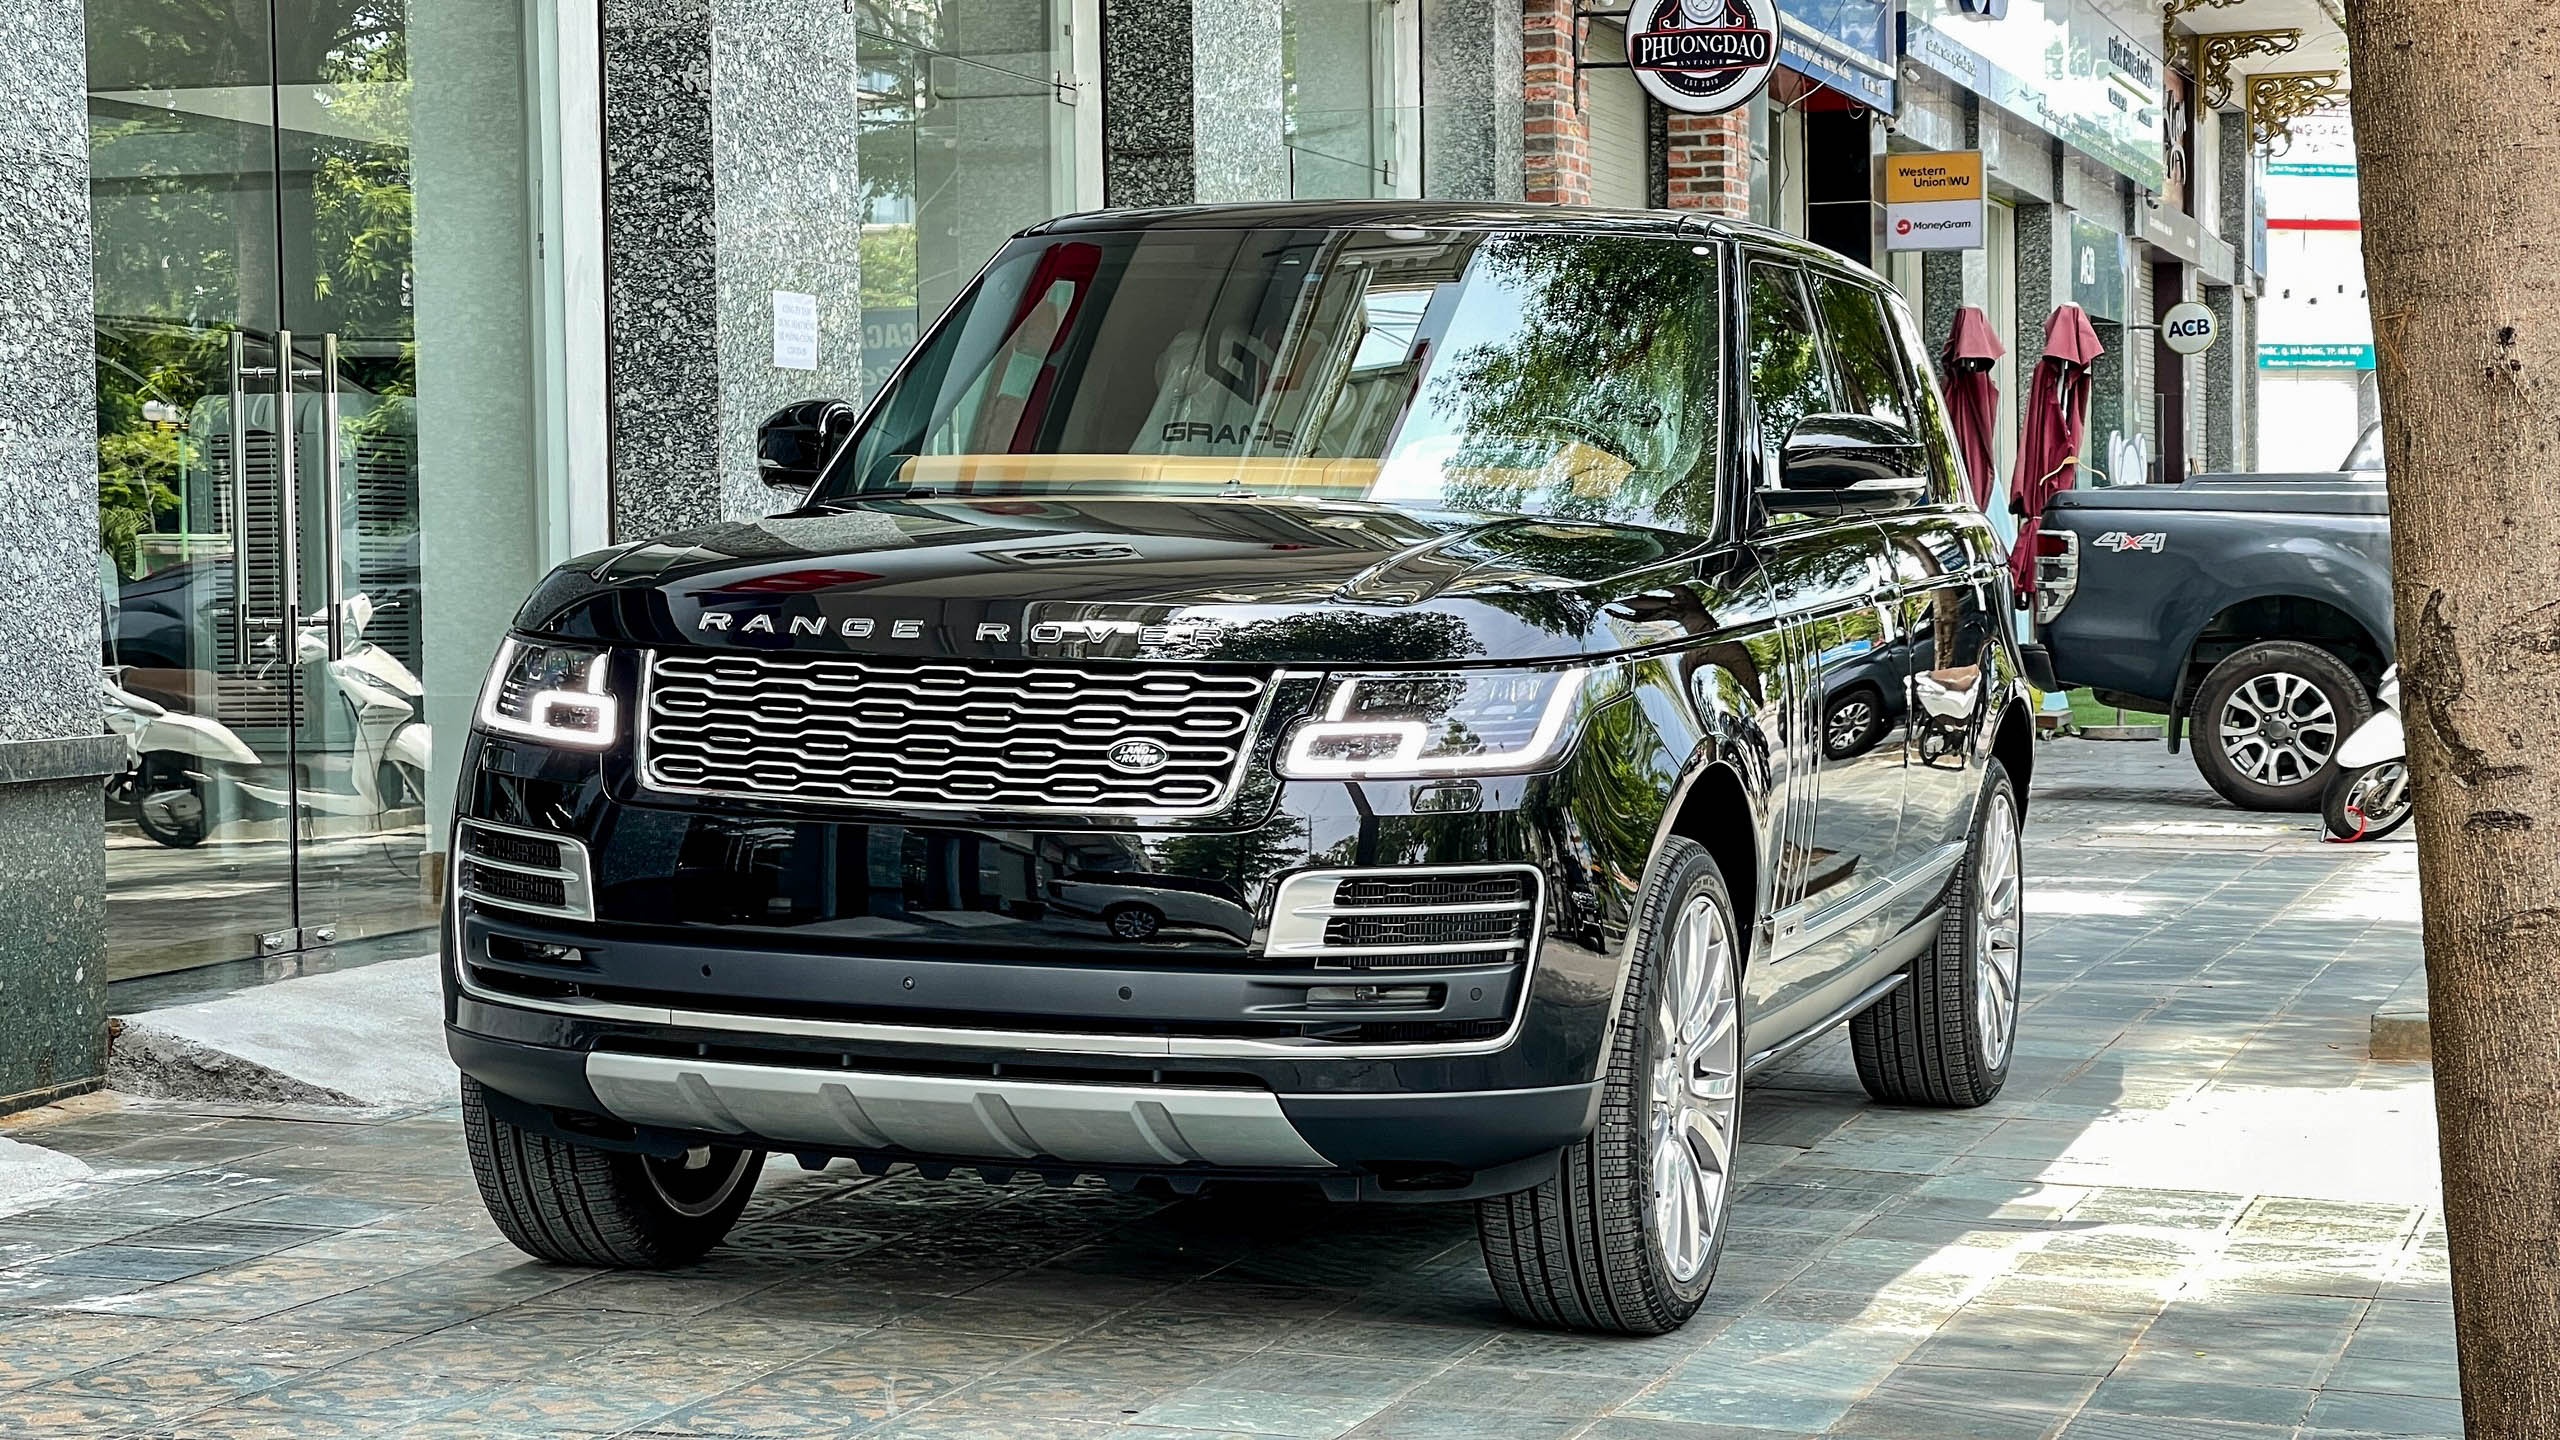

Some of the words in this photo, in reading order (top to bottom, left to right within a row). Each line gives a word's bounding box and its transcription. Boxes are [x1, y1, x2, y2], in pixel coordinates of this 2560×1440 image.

[1640, 33, 1766, 64] PHUONGDAO
[1679, 59, 1723, 67] ANTIQUE
[1684, 78, 1698, 87] EST
[1898, 167, 1946, 177] Western
[1913, 176, 1946, 188] Union
[1949, 175, 1970, 186] WU
[1913, 220, 1972, 231] MoneyGram
[2168, 318, 2211, 338] ACB
[699, 611, 924, 640] RANGE
[976, 623, 1226, 648] ROVER
[1120, 745, 1150, 754] LAND
[1121, 754, 1158, 764] ROVER
